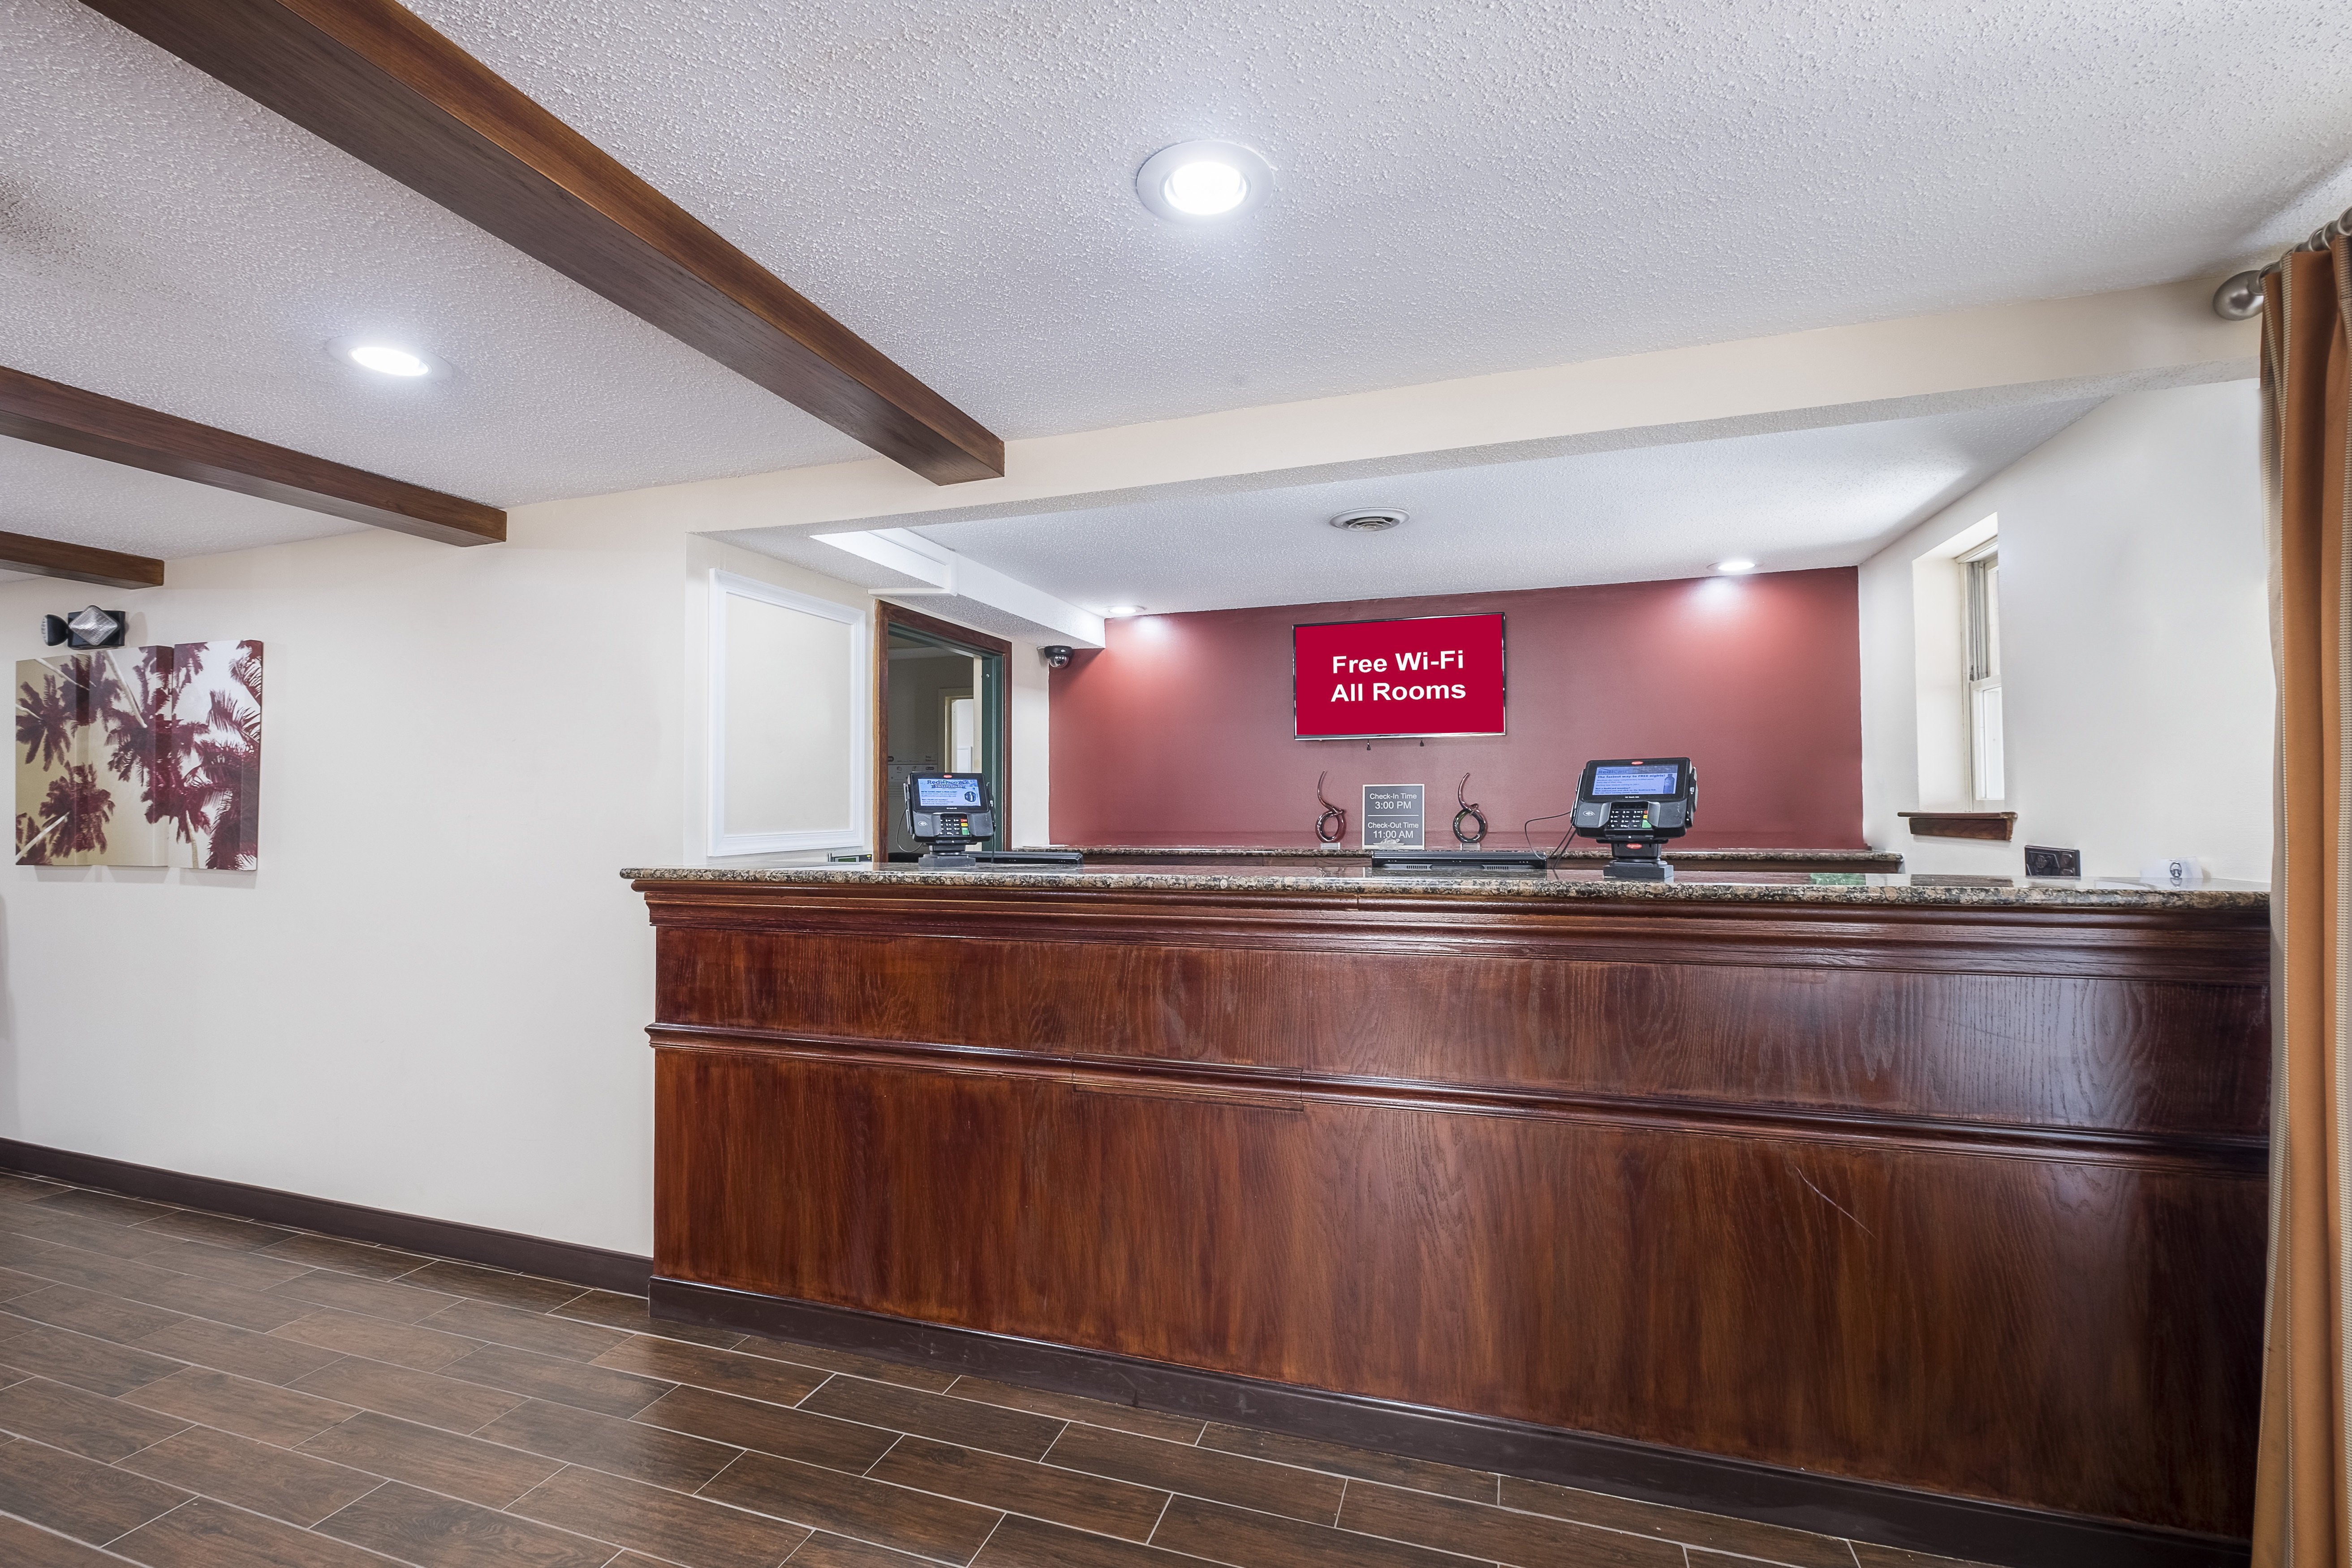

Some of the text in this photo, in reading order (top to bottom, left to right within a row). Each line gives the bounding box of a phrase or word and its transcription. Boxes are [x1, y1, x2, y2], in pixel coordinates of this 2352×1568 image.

[1333, 650, 1464, 674] Free Wi-Fi
[1331, 682, 1466, 702] All Rooms
[1375, 801, 1411, 809] 3:00 PM
[1398, 830, 1413, 838] AM
